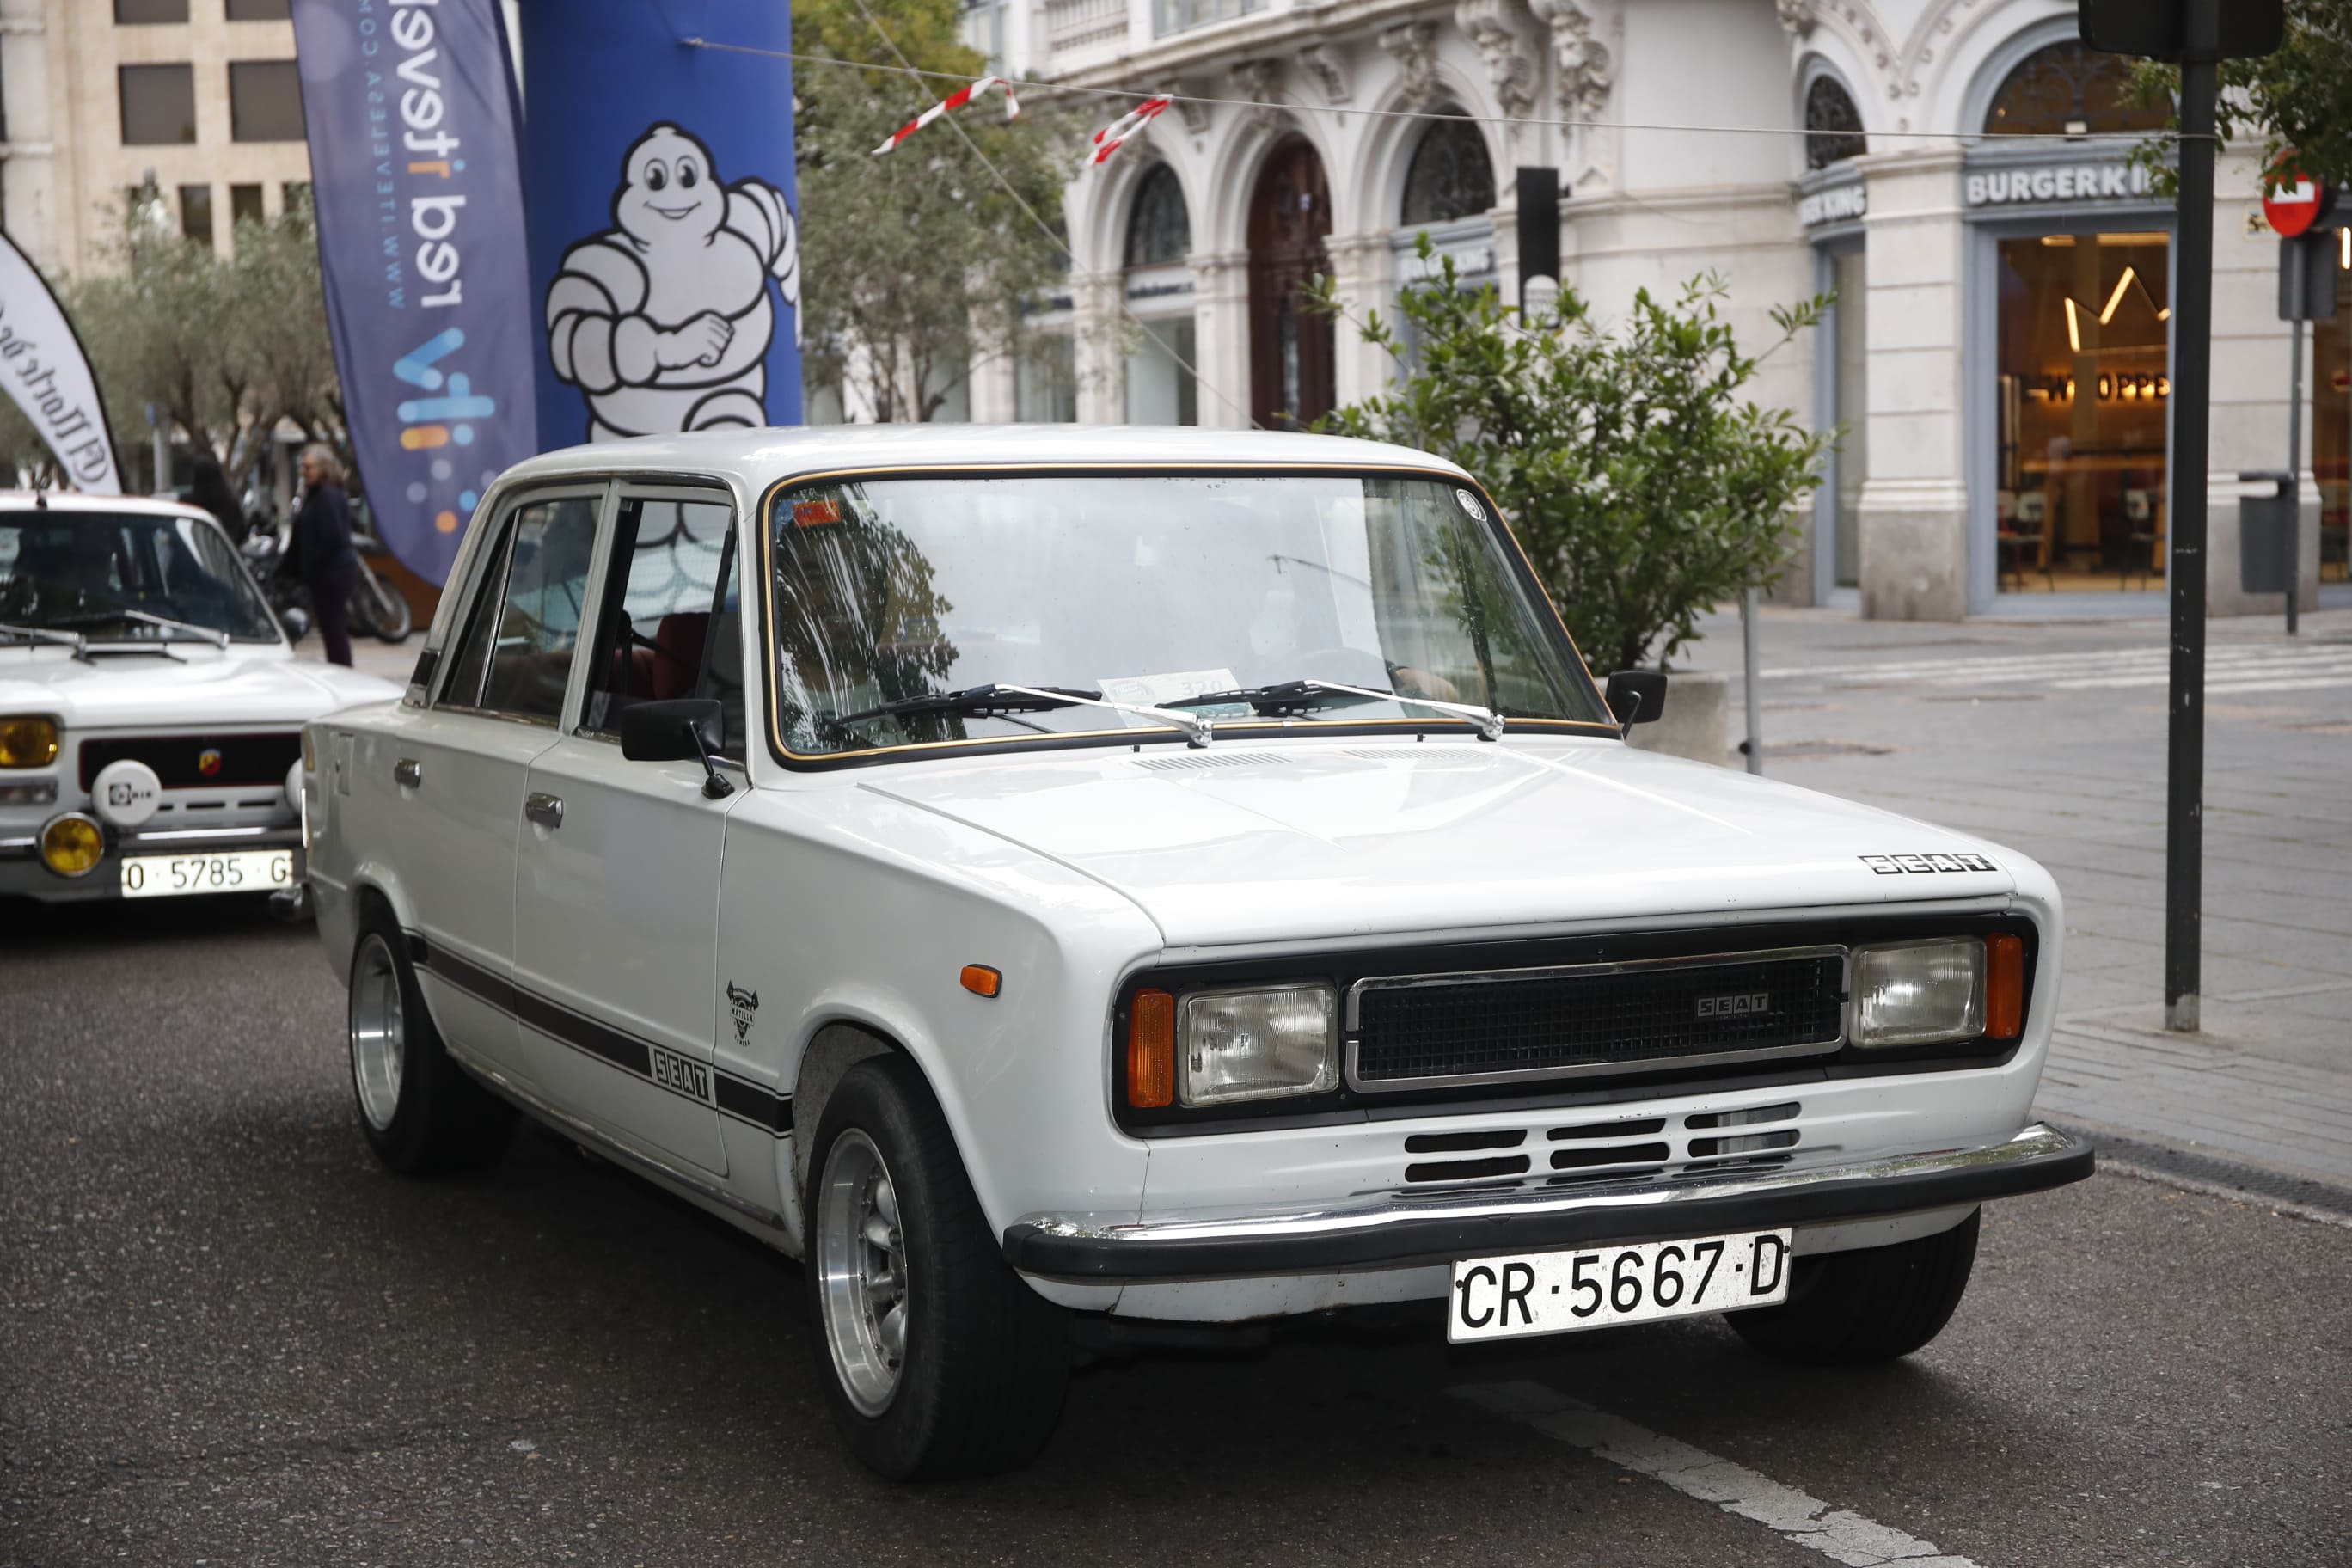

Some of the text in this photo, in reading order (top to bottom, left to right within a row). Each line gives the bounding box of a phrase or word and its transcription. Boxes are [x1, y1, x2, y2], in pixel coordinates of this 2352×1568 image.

[1967, 167, 2098, 205] BURGER
[171, 858, 243, 889] 5785
[271, 855, 288, 884] G
[1857, 853, 1998, 875] SEAT
[1698, 993, 1768, 1016] SEAT
[653, 1048, 710, 1102] SEAT
